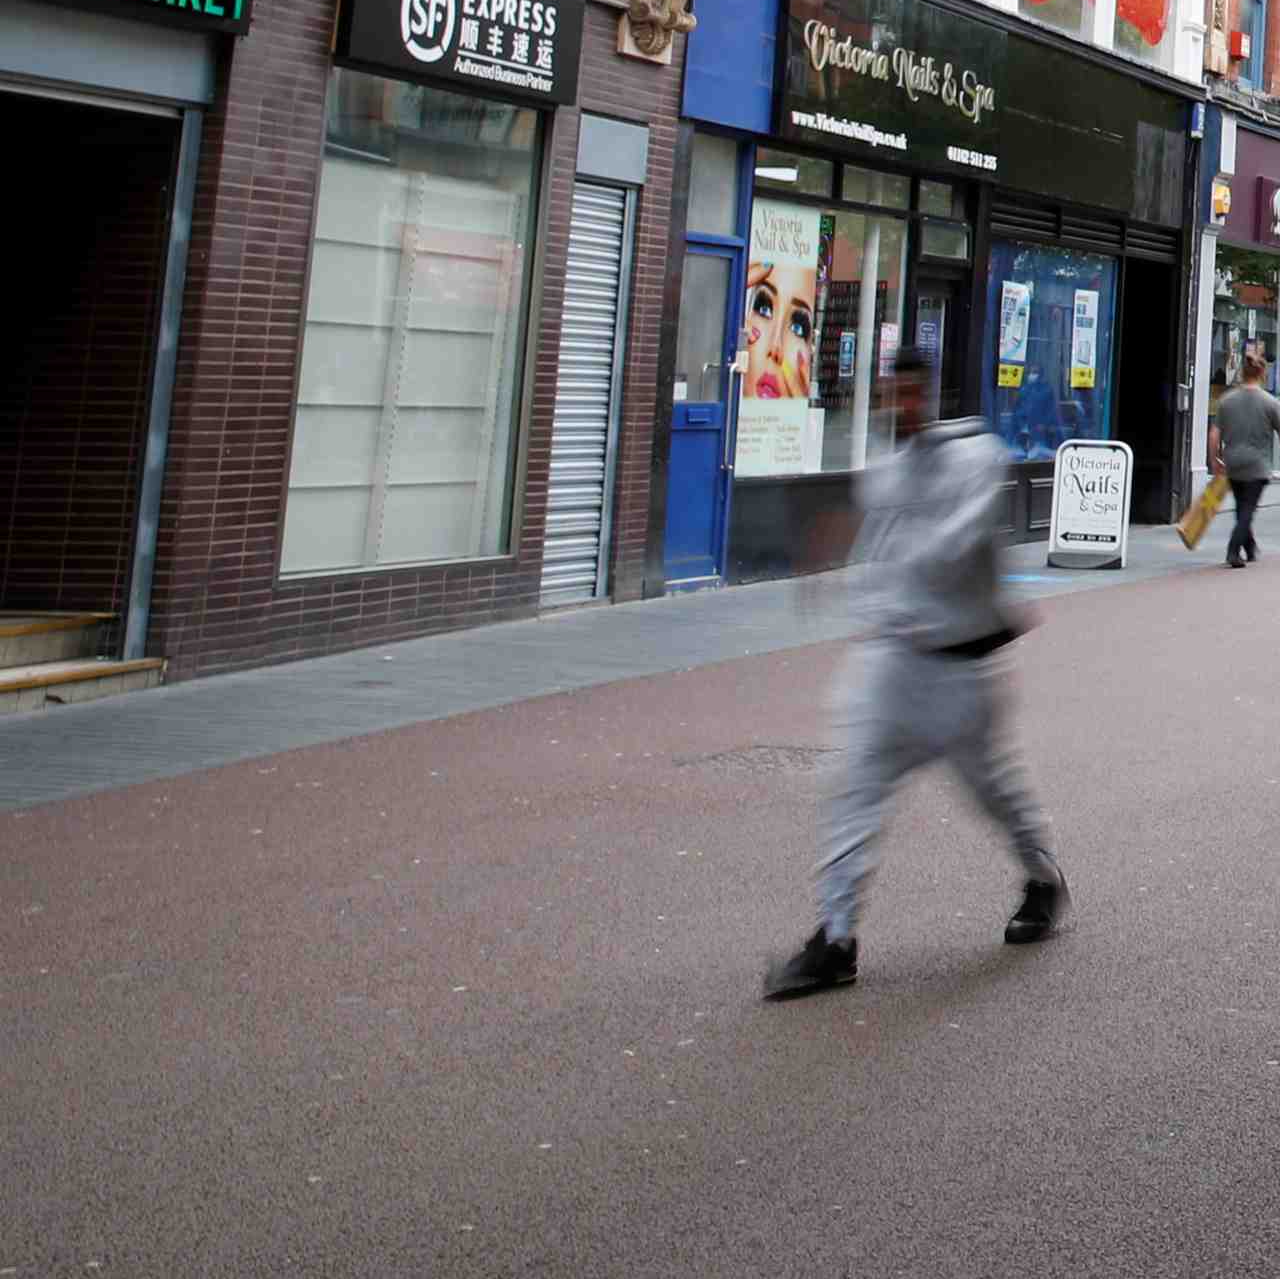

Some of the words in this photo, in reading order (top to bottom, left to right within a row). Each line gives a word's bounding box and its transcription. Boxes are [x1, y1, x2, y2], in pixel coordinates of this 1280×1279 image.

[459, 17, 553, 69] 顺丰速运
[495, 66, 526, 88] Business
[526, 72, 553, 92] Partner
[804, 19, 889, 81] Victoria
[893, 47, 940, 102] Nails
[942, 63, 959, 107] &
[960, 70, 995, 124] Spa
[763, 207, 802, 233] Victoria
[755, 228, 776, 251] Nail
[777, 236, 789, 252] &
[792, 234, 810, 259] Spa
[1066, 455, 1121, 471] Victoria
[1063, 473, 1119, 500] Nails
[1080, 501, 1088, 512] &
[1092, 500, 1118, 515] Spa
